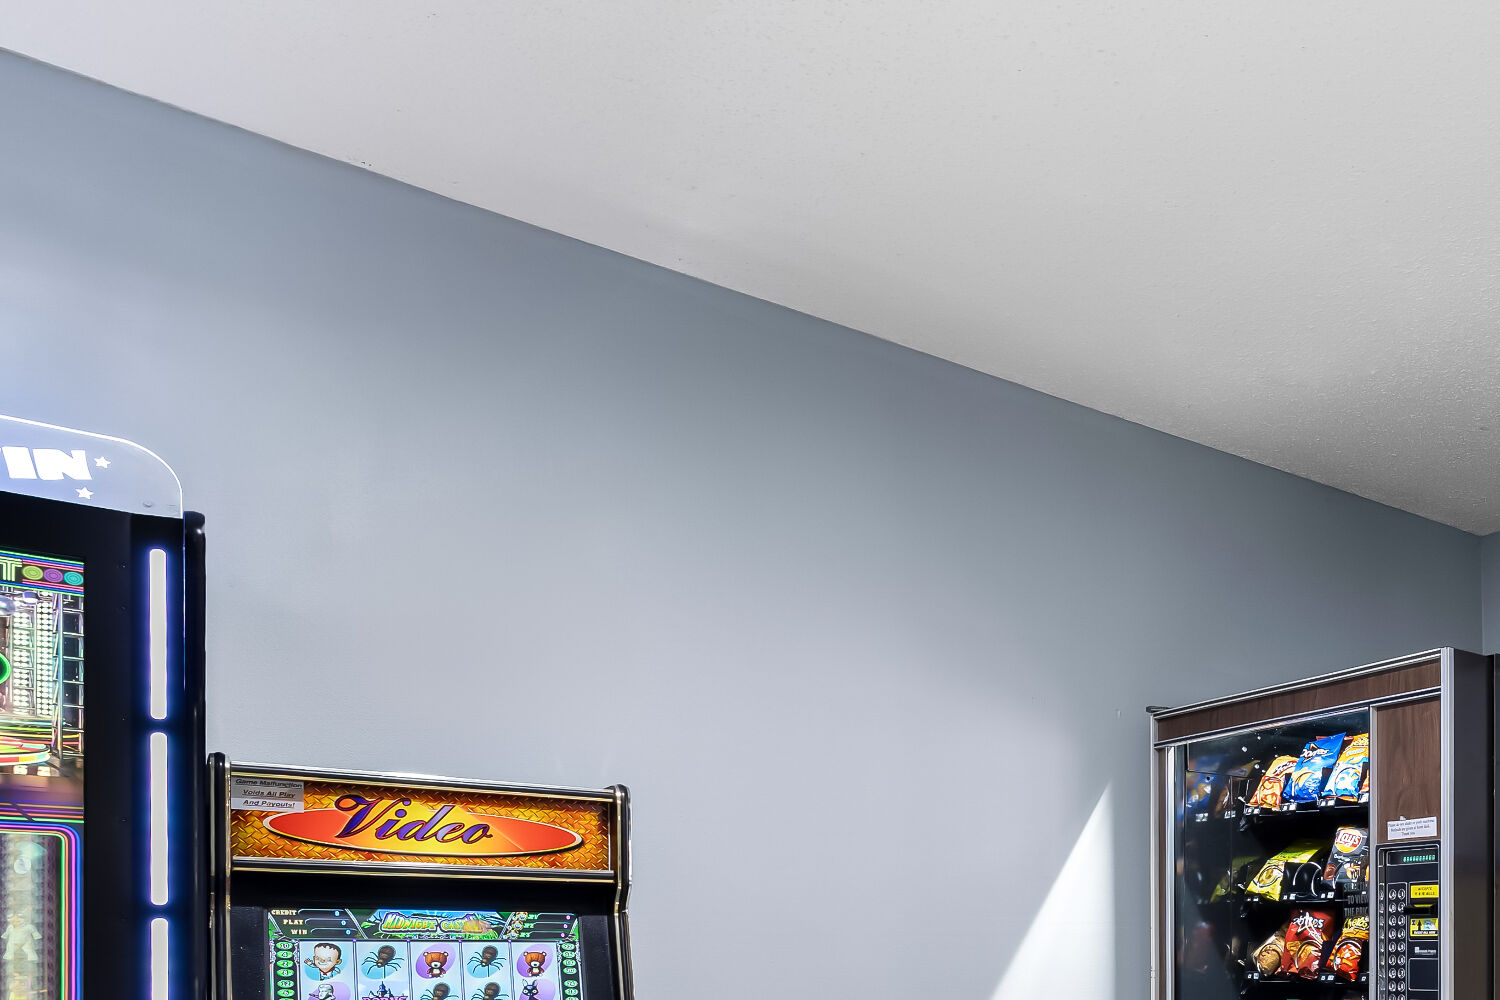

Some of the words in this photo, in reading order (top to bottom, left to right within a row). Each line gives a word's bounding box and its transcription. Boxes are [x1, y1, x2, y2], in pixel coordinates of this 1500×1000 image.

[0, 446, 93, 481] IN
[334, 794, 493, 844] Video
[382, 914, 437, 930] MIDNIGHT
